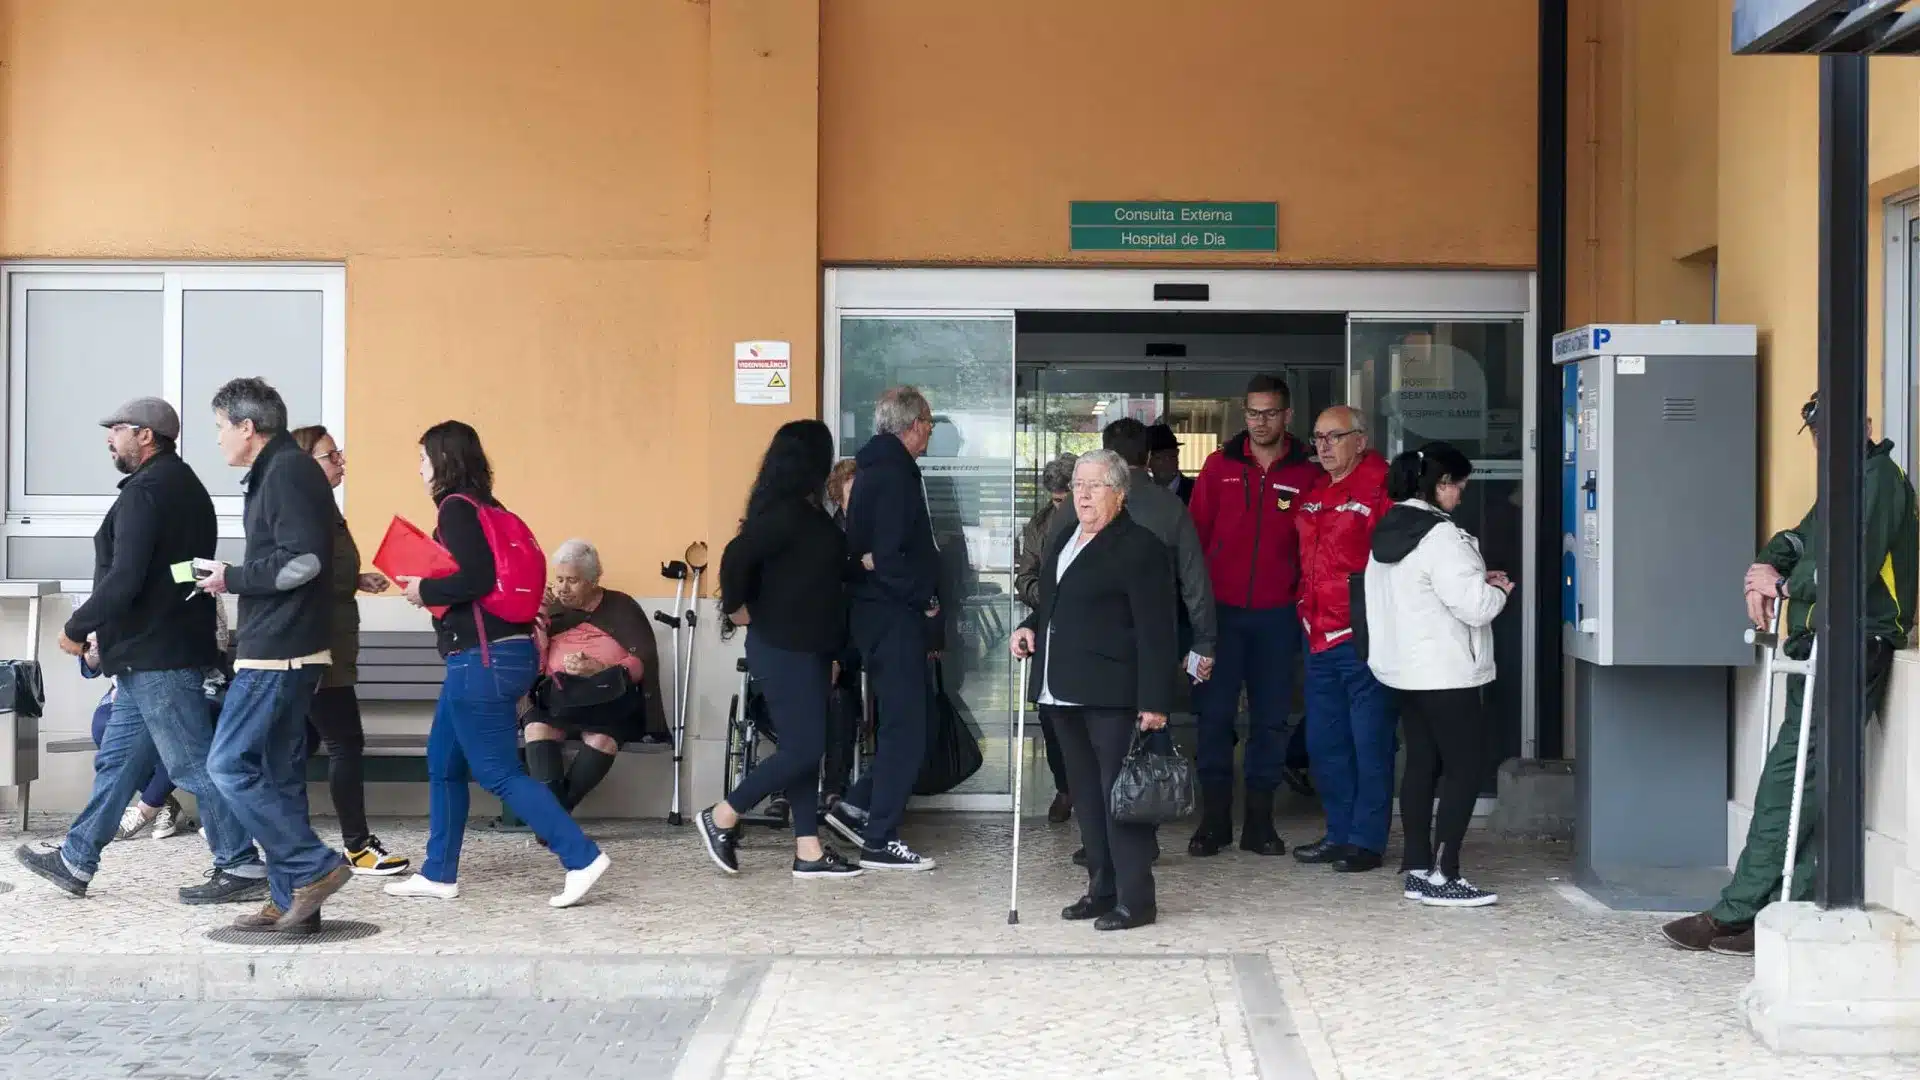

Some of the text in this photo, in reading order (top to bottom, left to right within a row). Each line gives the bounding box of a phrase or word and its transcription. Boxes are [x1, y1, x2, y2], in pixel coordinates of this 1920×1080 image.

[1114, 207, 1233, 221] Consulta Externa
[1121, 231, 1226, 246] Hospital de Dia
[1593, 328, 1611, 350] P
